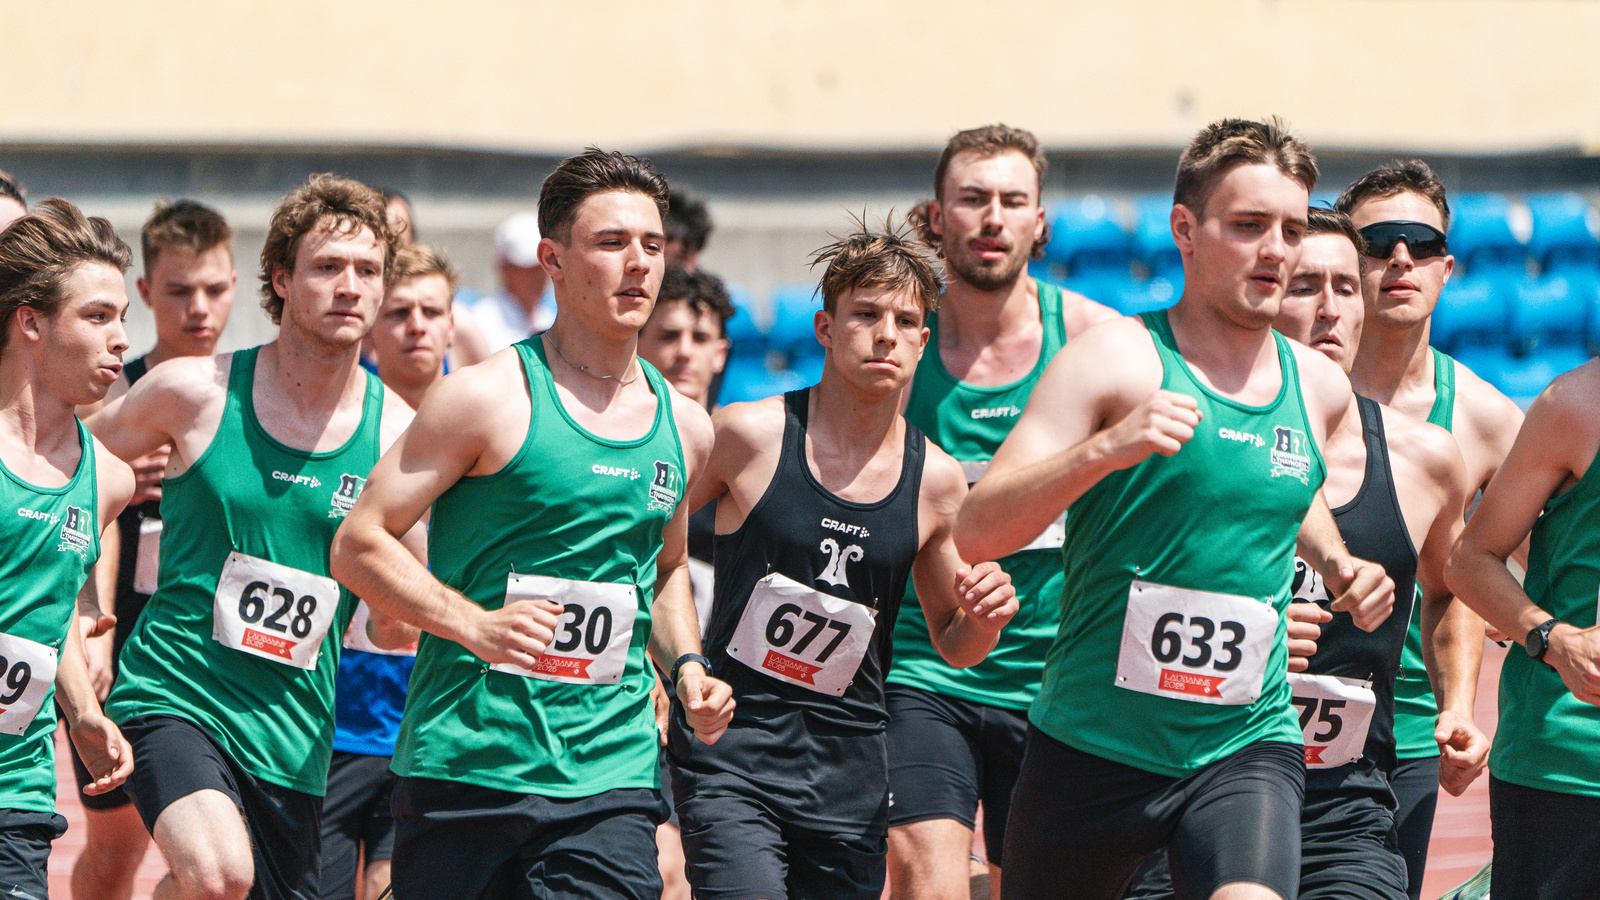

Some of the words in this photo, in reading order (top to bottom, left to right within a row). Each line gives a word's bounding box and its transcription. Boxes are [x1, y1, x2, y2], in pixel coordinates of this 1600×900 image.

[971, 405, 1011, 420] CRAFT
[1218, 427, 1257, 444] CRAFT
[272, 470, 311, 487] CRAFT
[592, 464, 631, 479] CRAFT
[17, 507, 50, 523] CRAFT
[820, 517, 861, 536] CRAFT
[238, 580, 317, 639] 628
[546, 600, 612, 656] 30
[765, 602, 852, 664] 677
[1151, 612, 1246, 673] 633
[1291, 696, 1347, 743] 75
